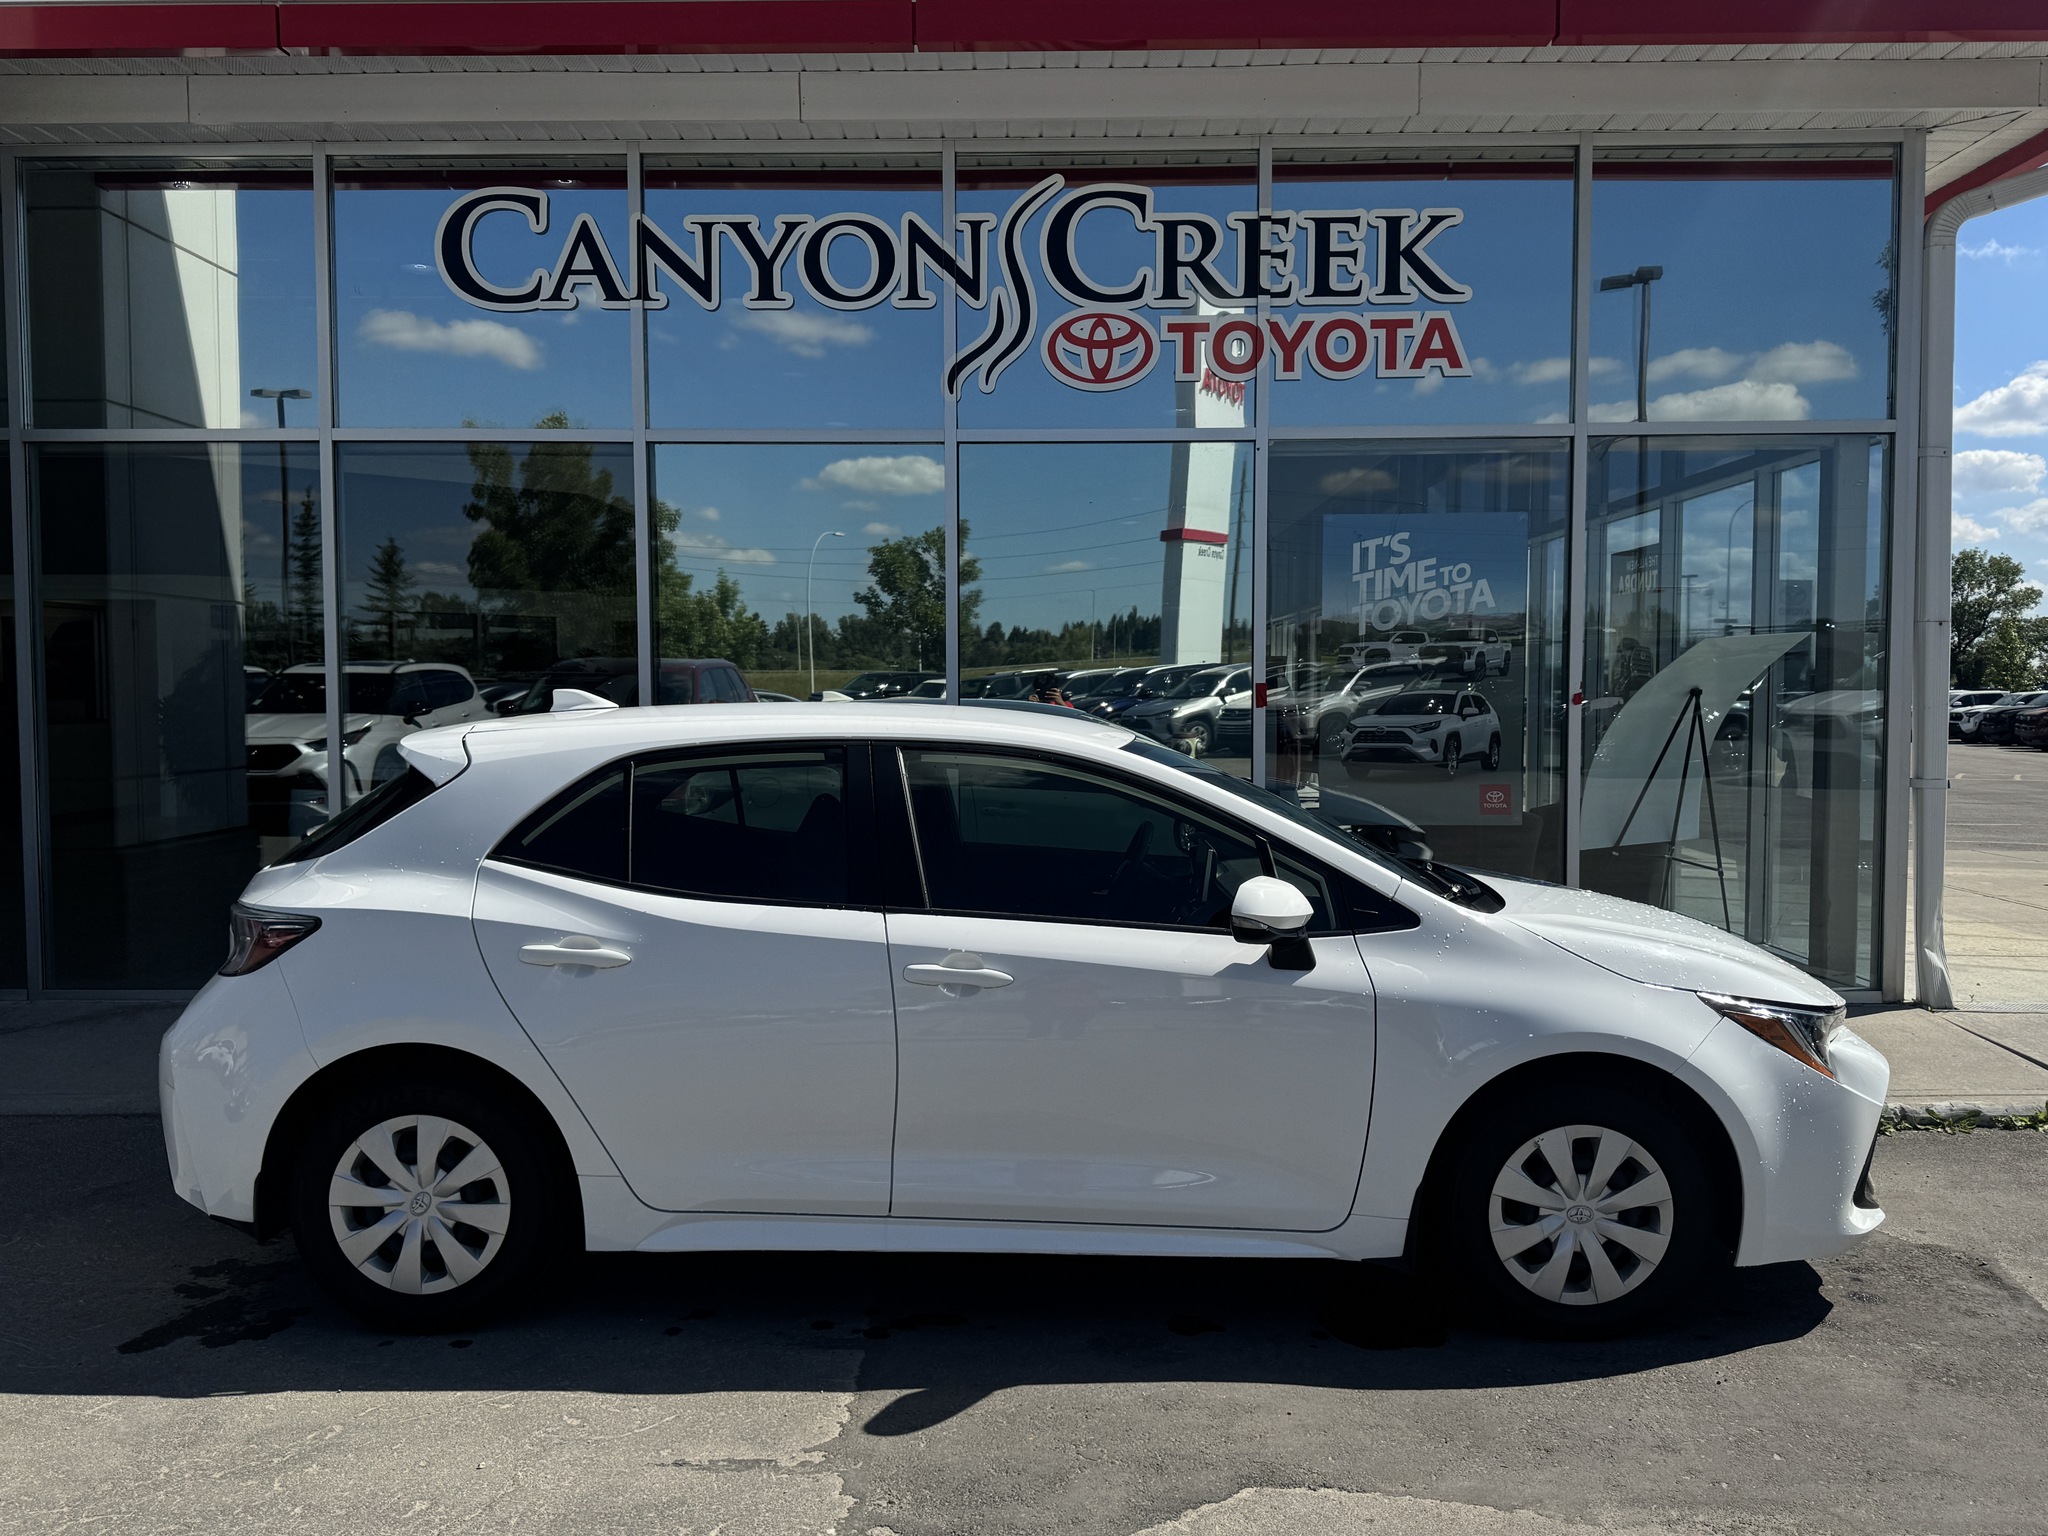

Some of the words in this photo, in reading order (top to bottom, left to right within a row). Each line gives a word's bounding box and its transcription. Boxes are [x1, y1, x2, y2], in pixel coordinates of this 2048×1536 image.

[436, 188, 995, 310] CANYON
[1042, 185, 1470, 305] CREEK
[1164, 314, 1467, 377] TOYOTA
[1352, 532, 1411, 574] IT'S
[1352, 557, 1437, 605] TIME
[1440, 563, 1472, 586] TO
[1351, 578, 1497, 636] TOYOTA
